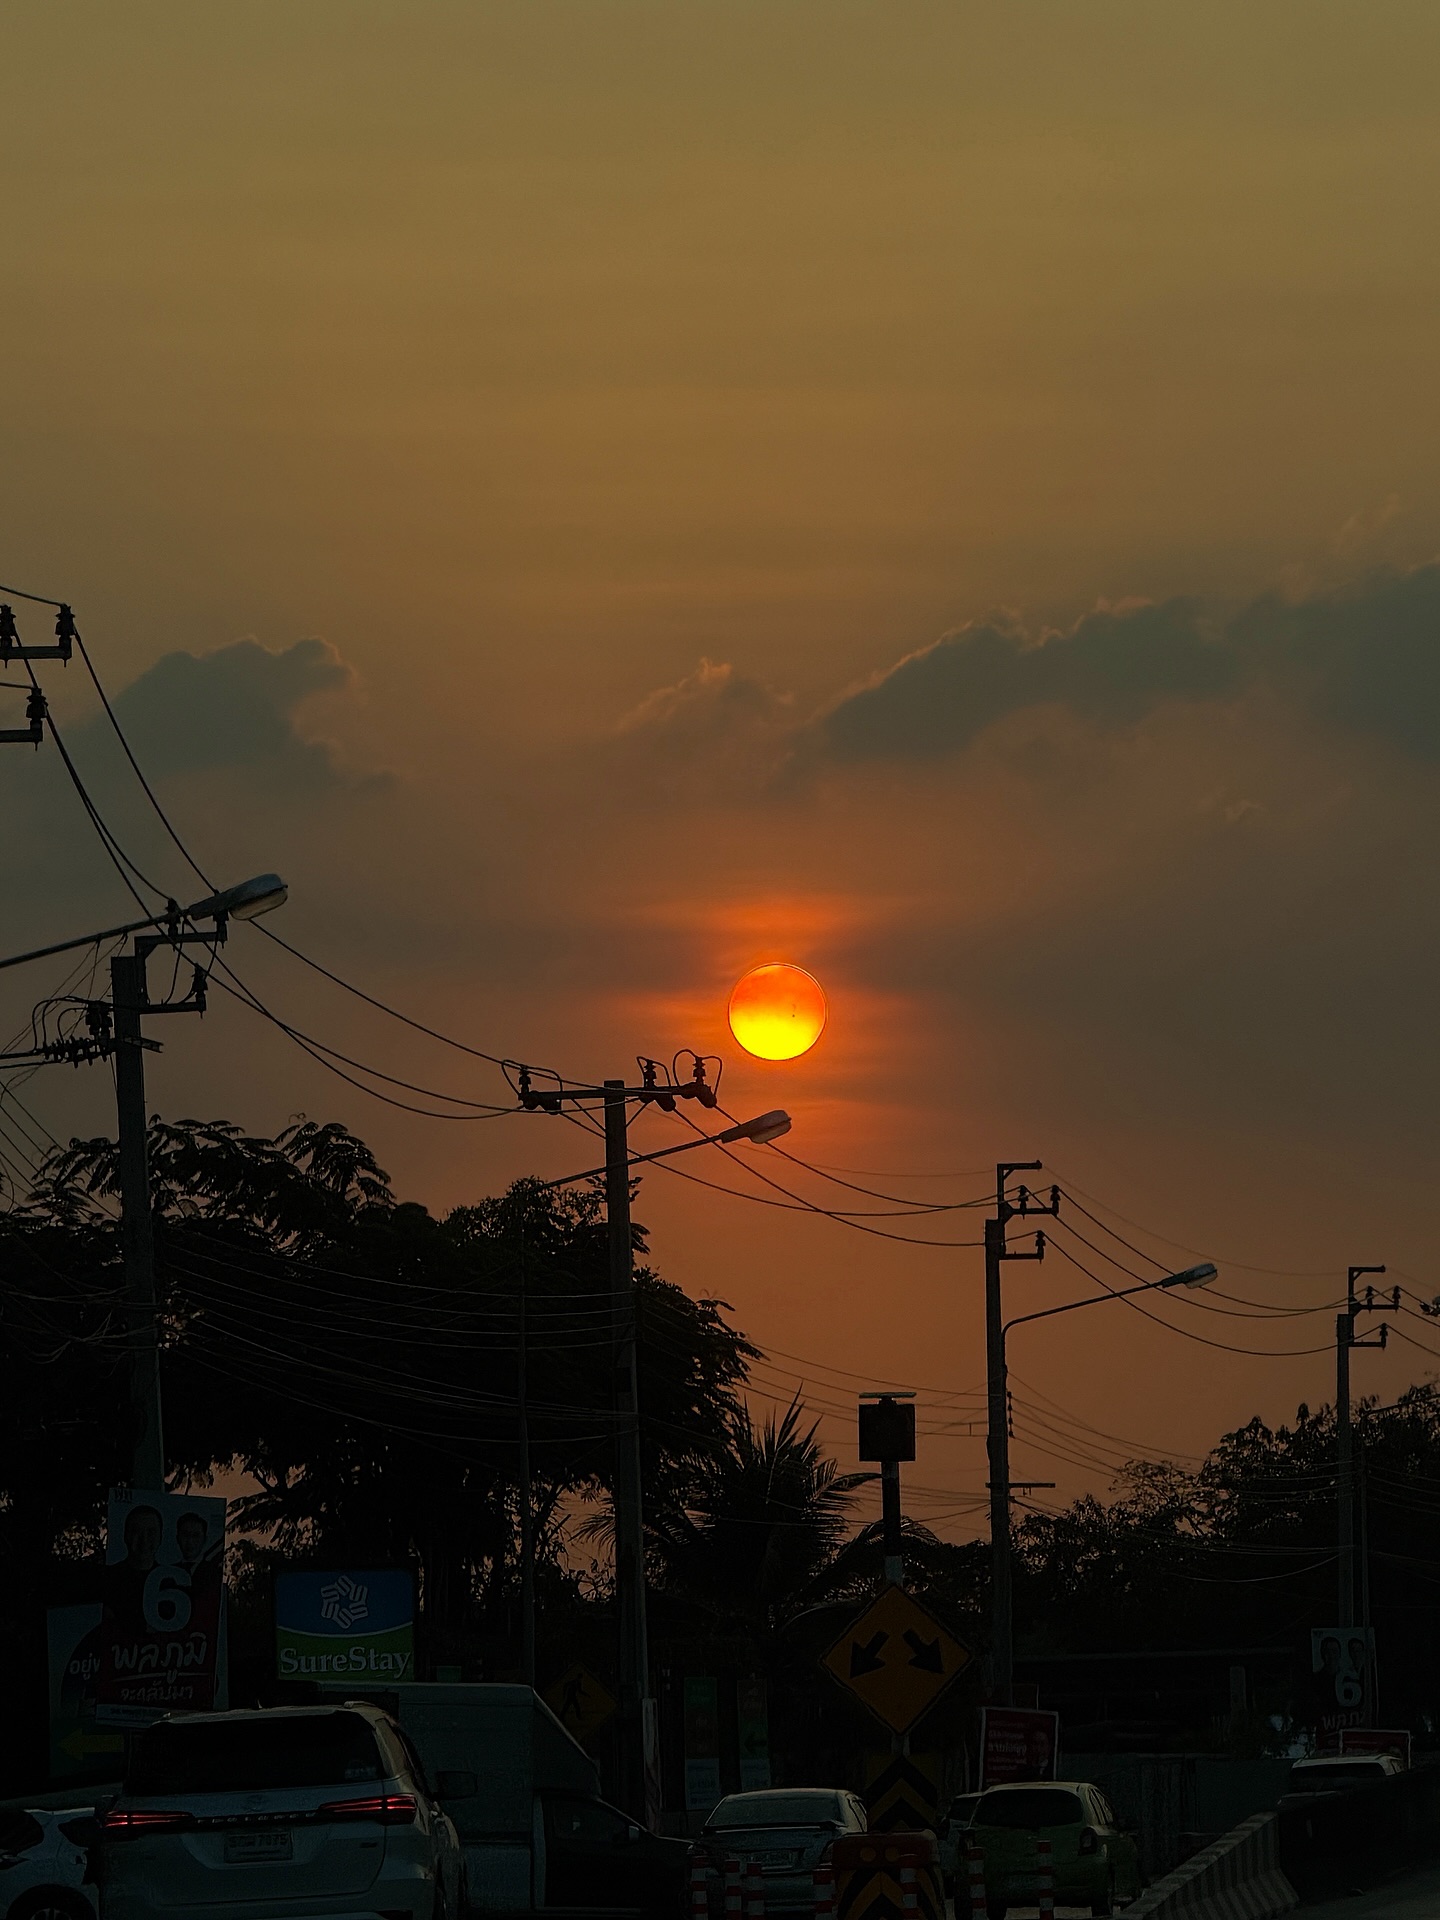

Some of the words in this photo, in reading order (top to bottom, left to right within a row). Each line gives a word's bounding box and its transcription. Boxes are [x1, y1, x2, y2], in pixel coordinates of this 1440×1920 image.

[143, 1565, 192, 1632] 6
[111, 1632, 208, 1684] พลภูมิ
[280, 1646, 411, 1679] SureStay
[1335, 1668, 1362, 1707] 6
